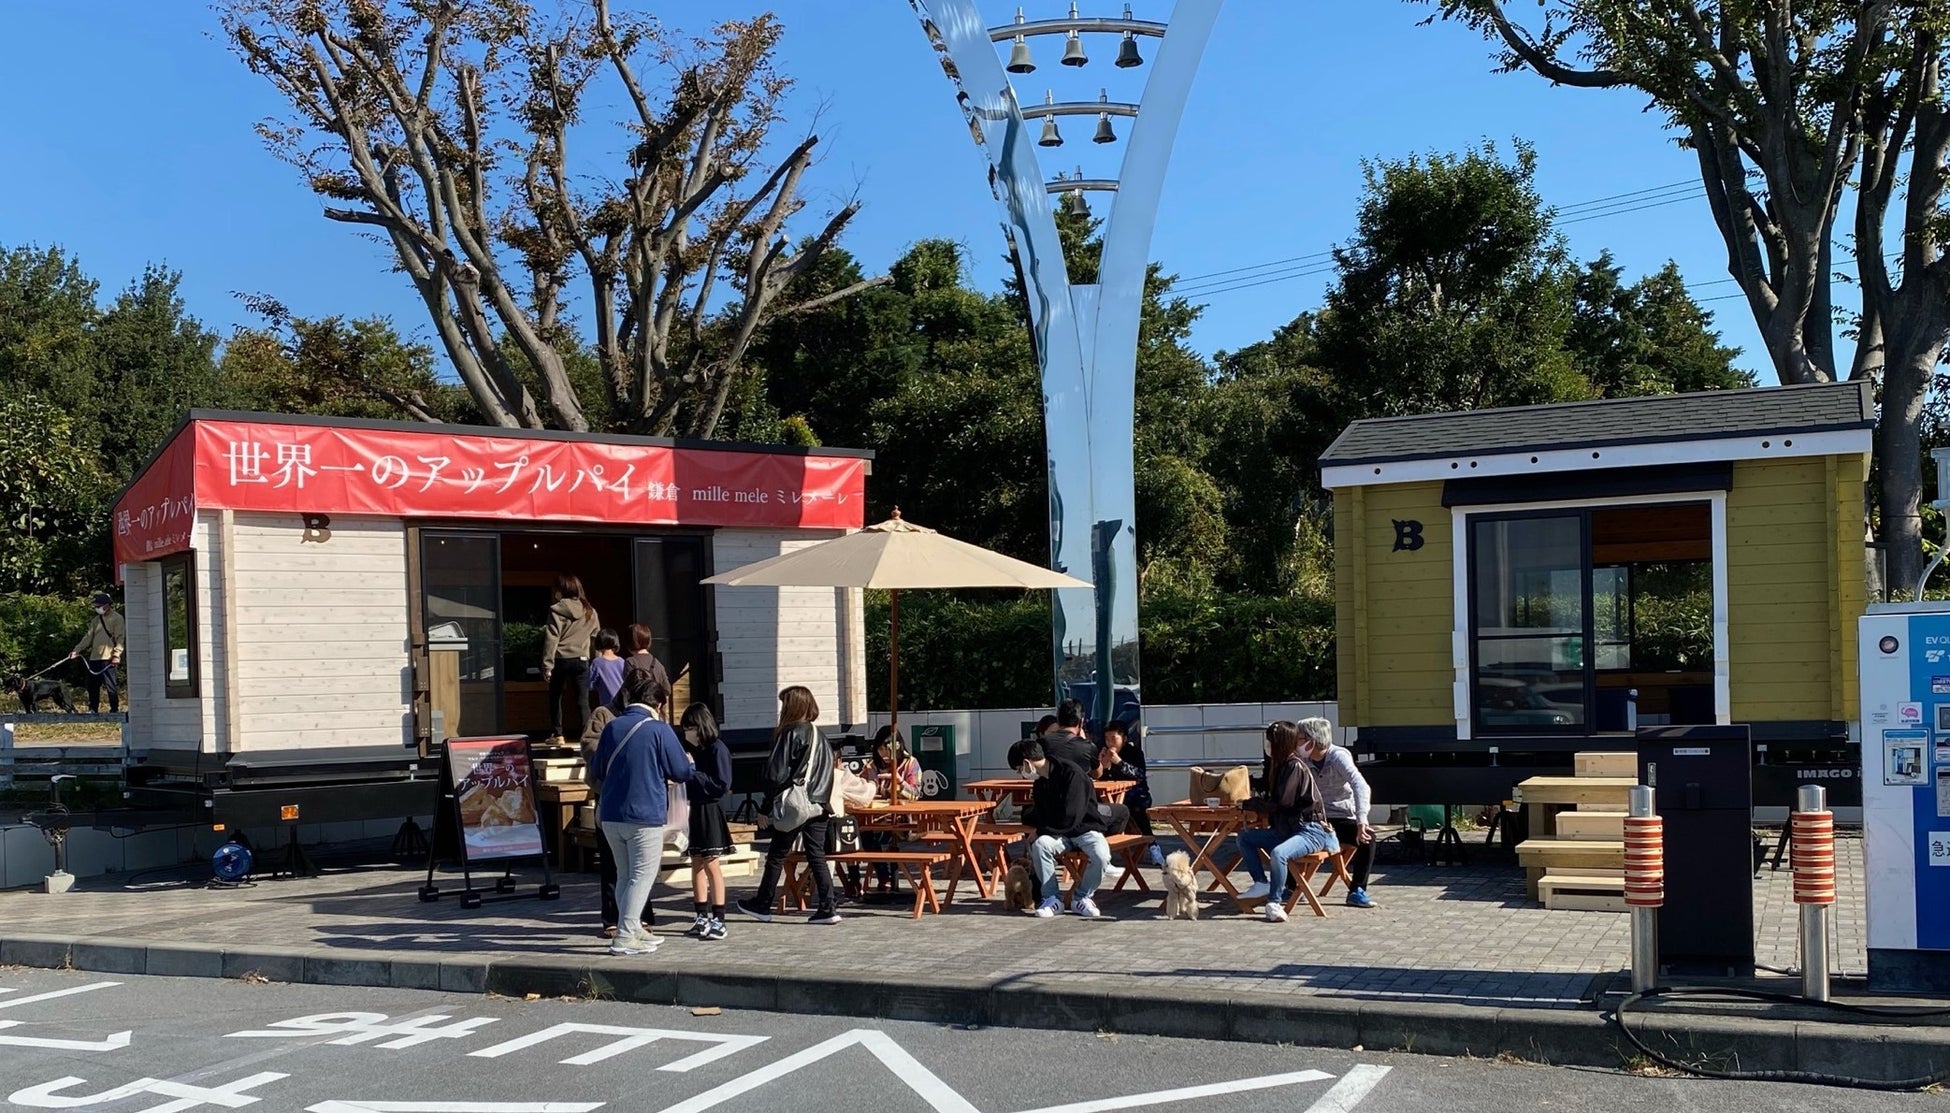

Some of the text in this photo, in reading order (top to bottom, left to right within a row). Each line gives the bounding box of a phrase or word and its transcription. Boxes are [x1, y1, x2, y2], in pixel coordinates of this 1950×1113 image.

[222, 441, 849, 505] 世界一のアップルパイ 鎌倉 mille mele ミレメーレ
[300, 514, 332, 545] B
[1391, 518, 1425, 553] B
[1925, 636, 1938, 645] EV
[1797, 768, 1853, 778] IMAGO
